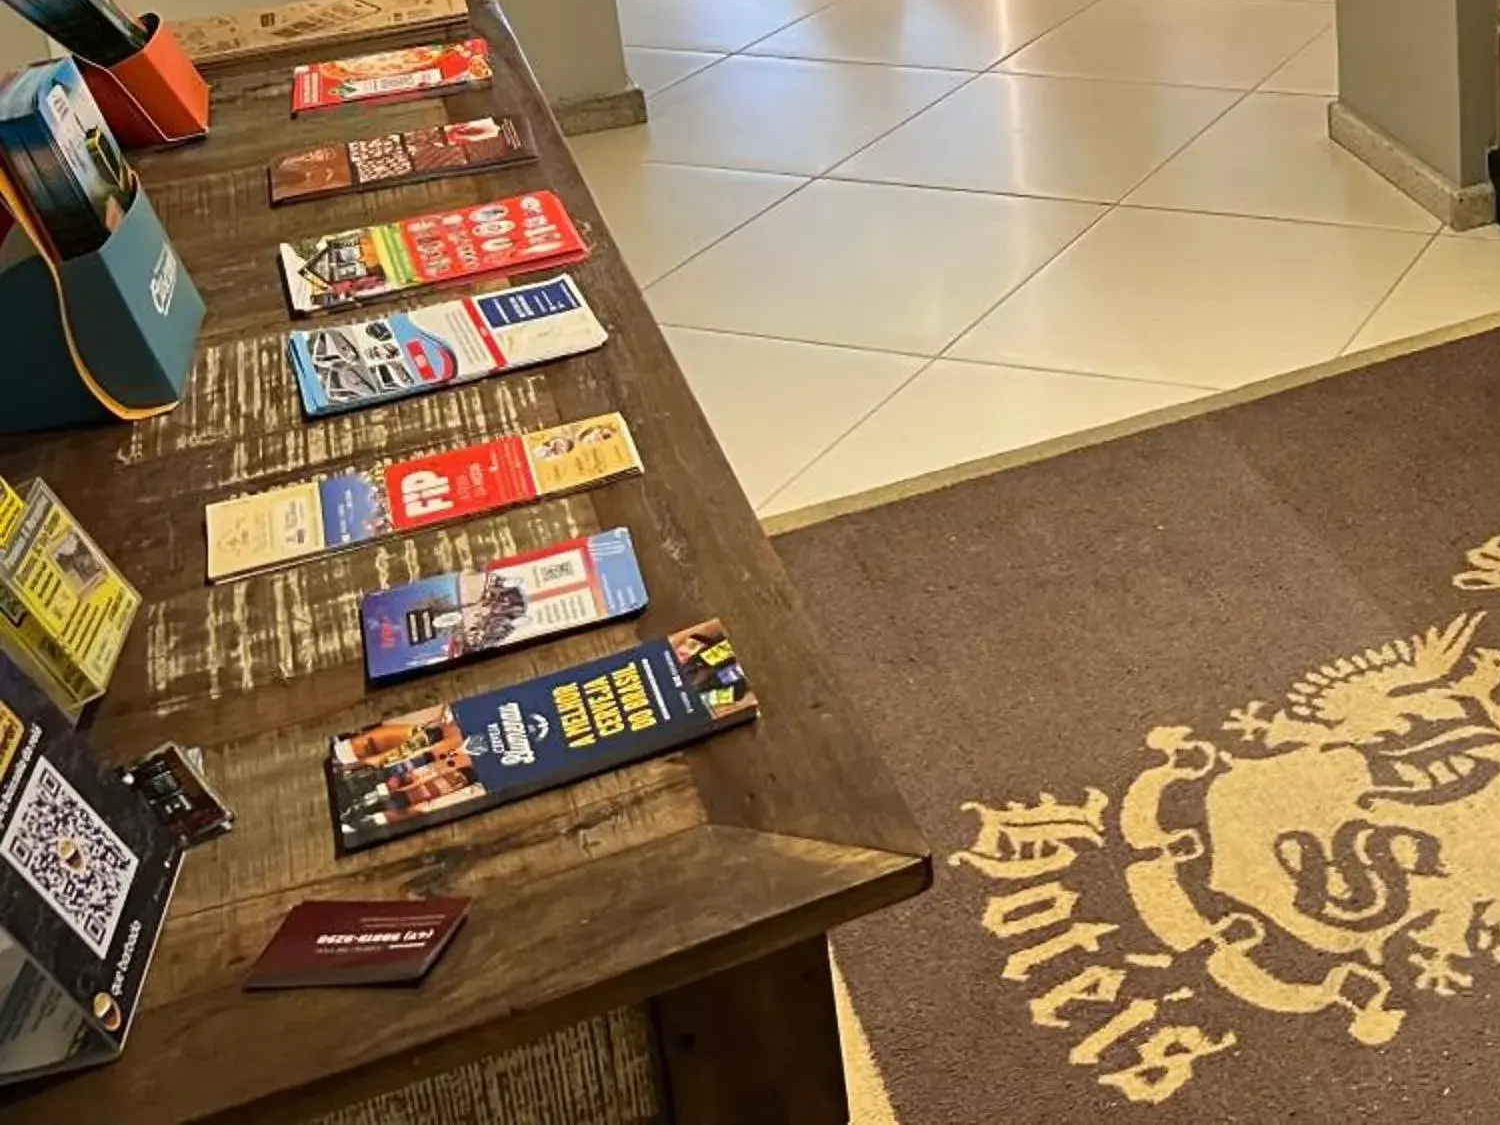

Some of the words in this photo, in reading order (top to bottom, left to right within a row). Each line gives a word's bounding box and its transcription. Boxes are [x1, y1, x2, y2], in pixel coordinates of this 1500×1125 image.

[583, 674, 625, 737] CERVEJA
[611, 660, 650, 712] BRASIL
[948, 786, 1236, 1104] Hotéis
